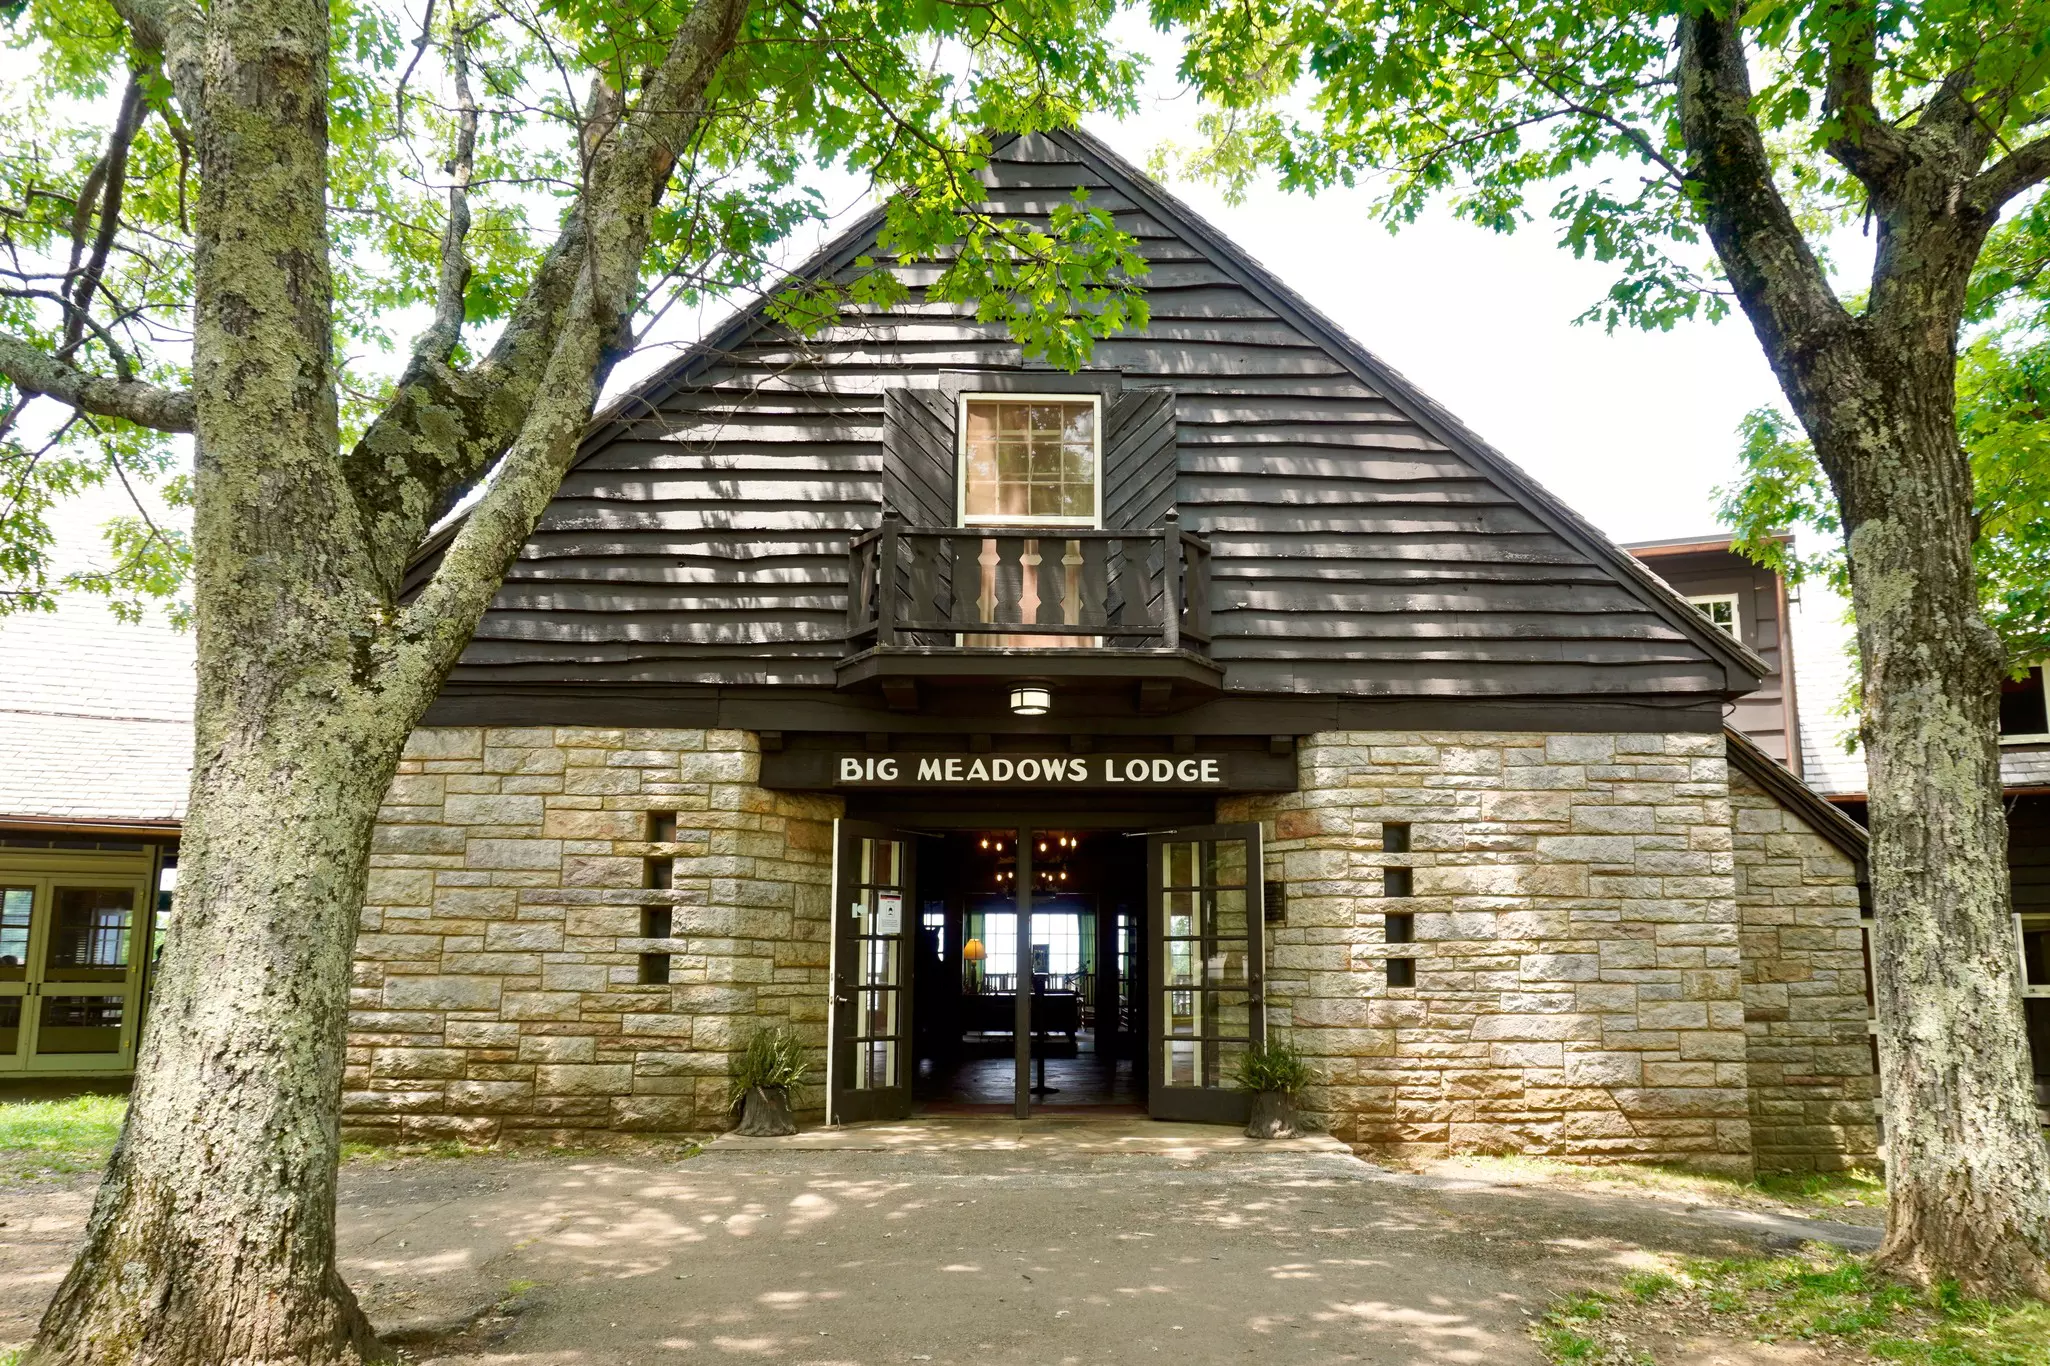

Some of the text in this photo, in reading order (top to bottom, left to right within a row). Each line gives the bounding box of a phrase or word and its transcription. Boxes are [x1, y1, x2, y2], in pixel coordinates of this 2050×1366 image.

[840, 757, 1221, 782] BIG MEADOWS LODGE
